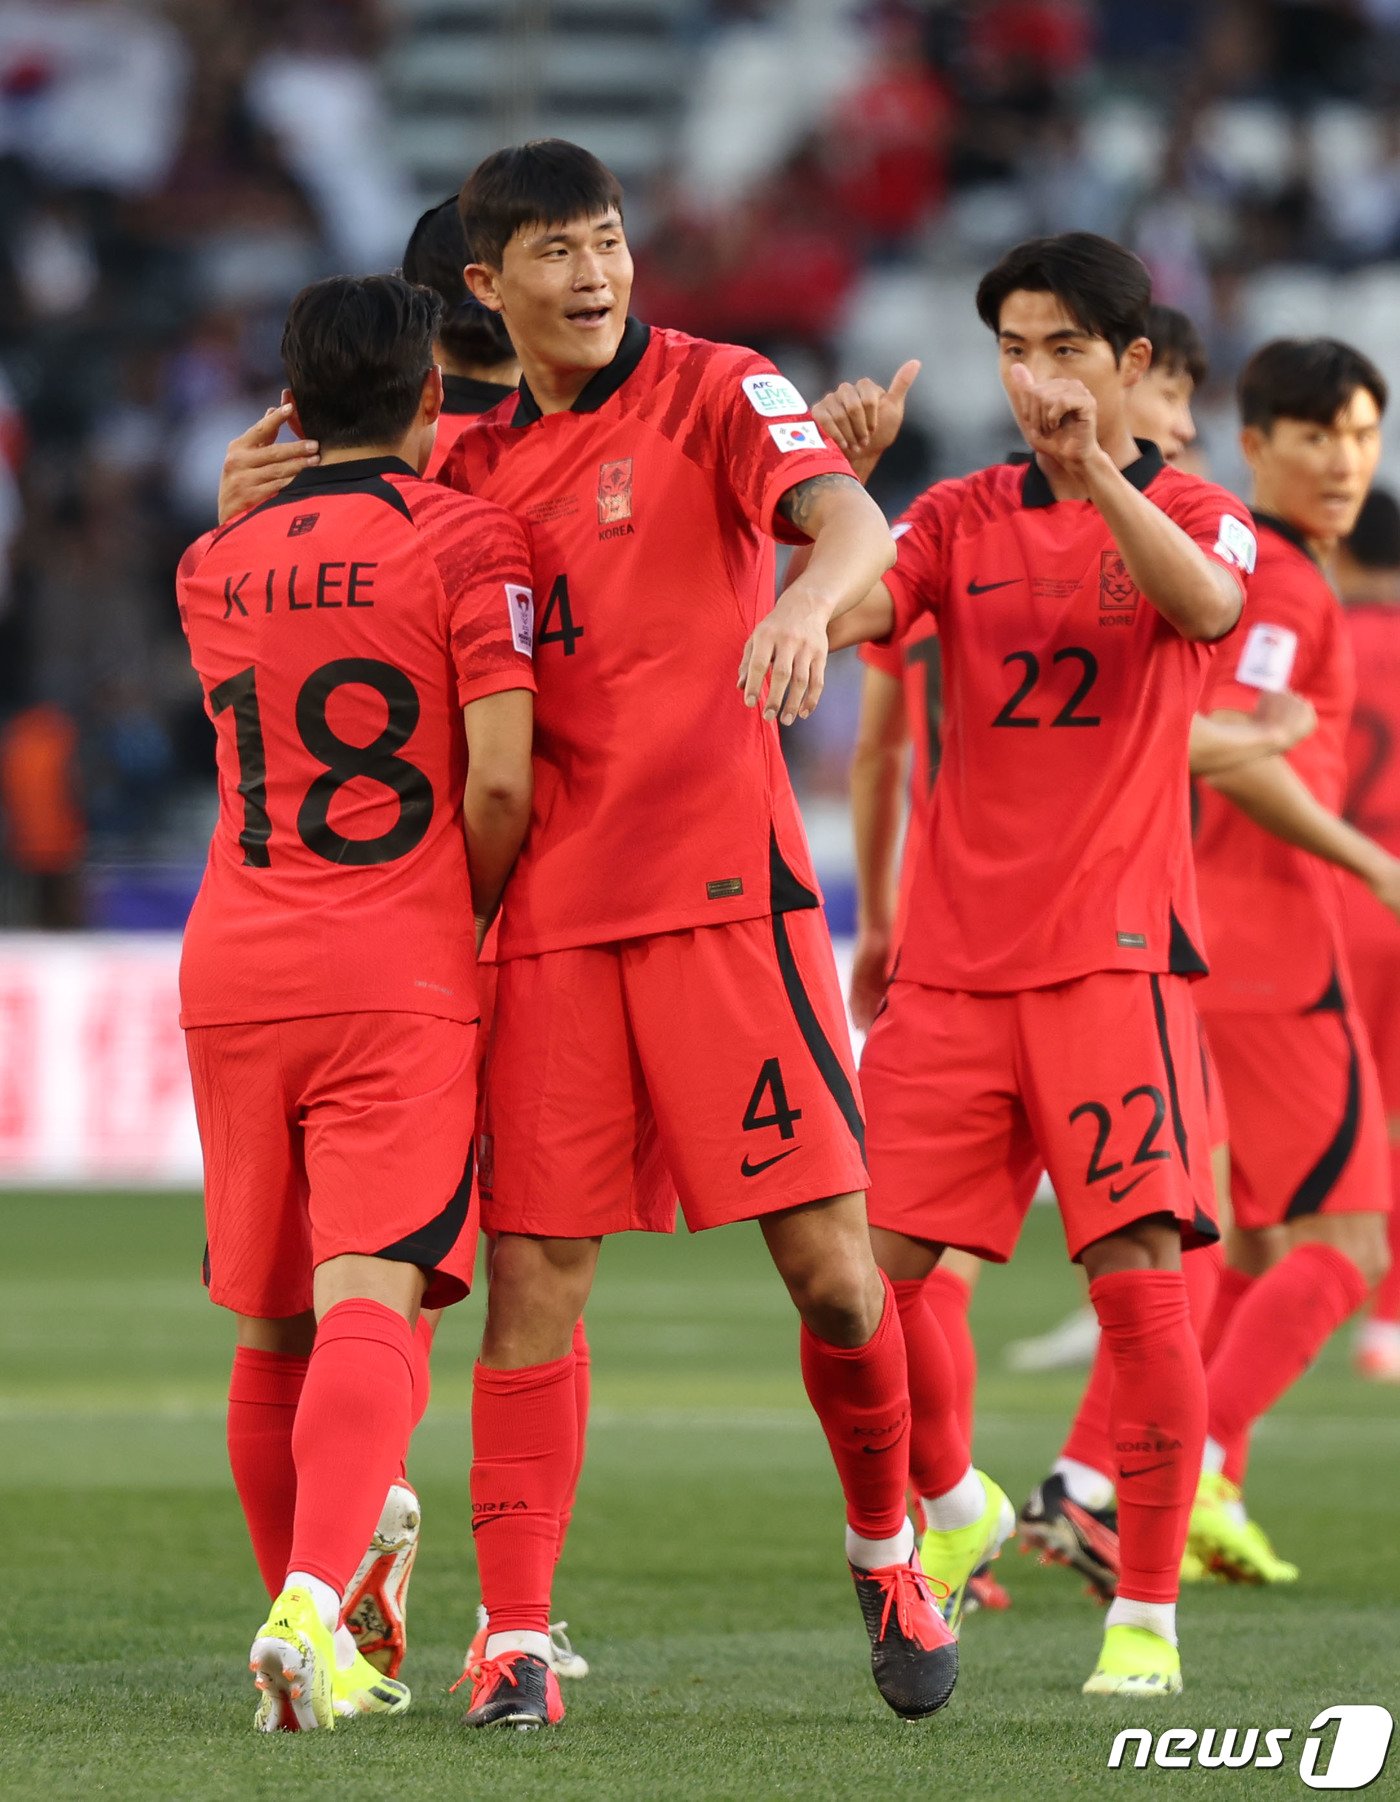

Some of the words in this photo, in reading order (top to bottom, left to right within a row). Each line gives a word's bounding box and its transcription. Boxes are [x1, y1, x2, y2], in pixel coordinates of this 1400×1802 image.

[753, 381, 773, 389] AFC
[755, 387, 791, 401] LIVE
[598, 524, 635, 541] KOREA
[537, 573, 585, 657] 4
[1098, 615, 1135, 627] KORE
[990, 646, 1102, 728] 22
[208, 657, 435, 869] 18
[742, 1056, 802, 1141] 4
[1069, 1084, 1172, 1186] 22
[853, 1411, 906, 1437] KOR
[1115, 1439, 1184, 1453] KOREA
[471, 1500, 529, 1513] OREA
